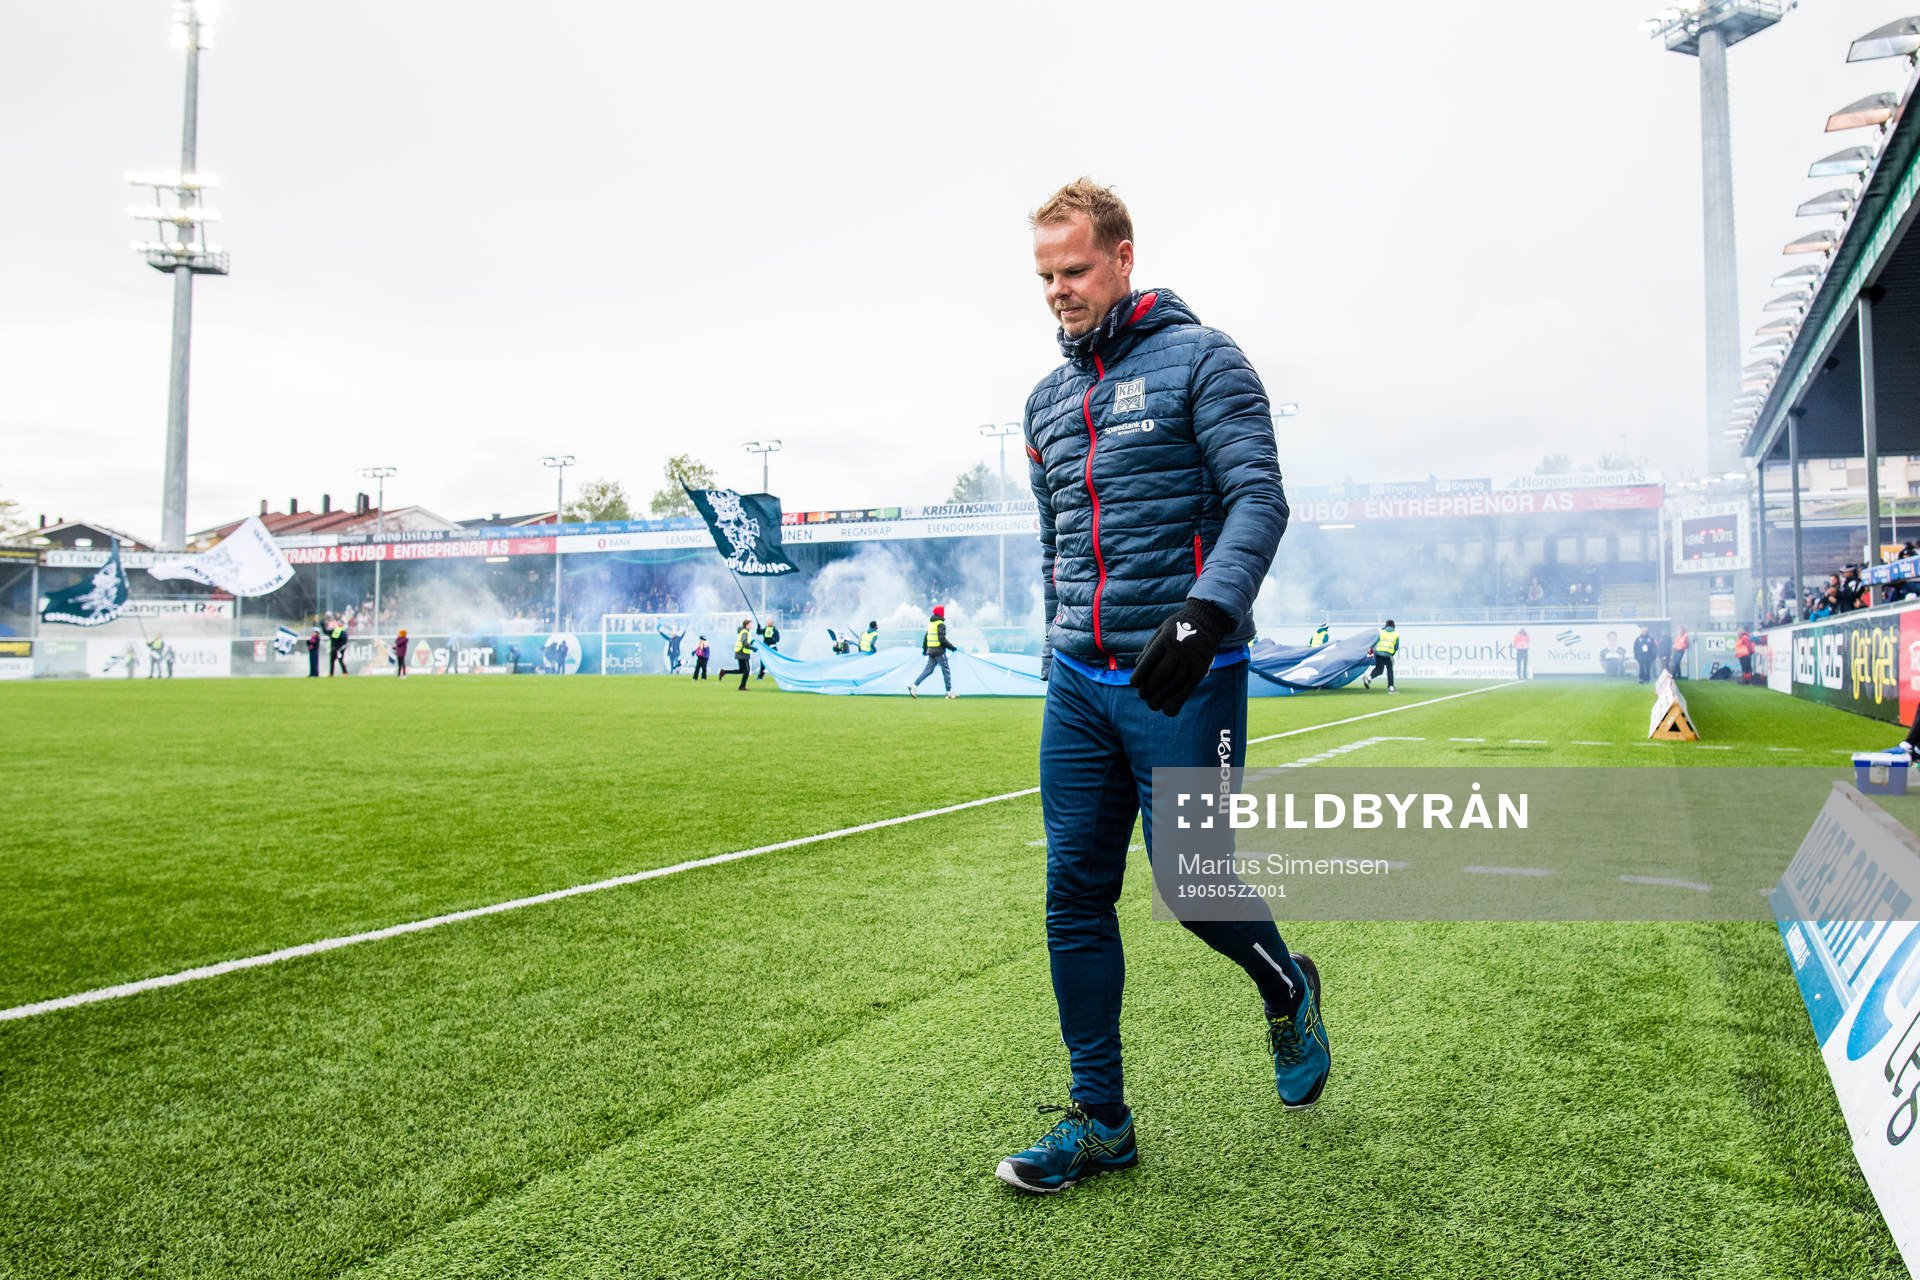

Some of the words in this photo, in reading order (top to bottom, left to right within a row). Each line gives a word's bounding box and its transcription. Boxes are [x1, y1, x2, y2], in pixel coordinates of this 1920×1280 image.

[1104, 421, 1141, 436] SpareBank
[1626, 471, 1647, 483] AS
[922, 503, 1002, 516] KRISTIANSUND
[1007, 501, 1039, 513] TAUB
[1365, 493, 1534, 519] ENTREPRENØR
[1542, 491, 1576, 512] AS
[841, 526, 892, 537] REGNSKAP
[927, 519, 1030, 534] EIENDOMSMEGLING
[491, 539, 509, 556] AS
[666, 534, 702, 545] LEASING
[1397, 639, 1516, 665] nutepunkt
[1217, 729, 1231, 814] macron
[1816, 848, 1913, 988] DRIFT
